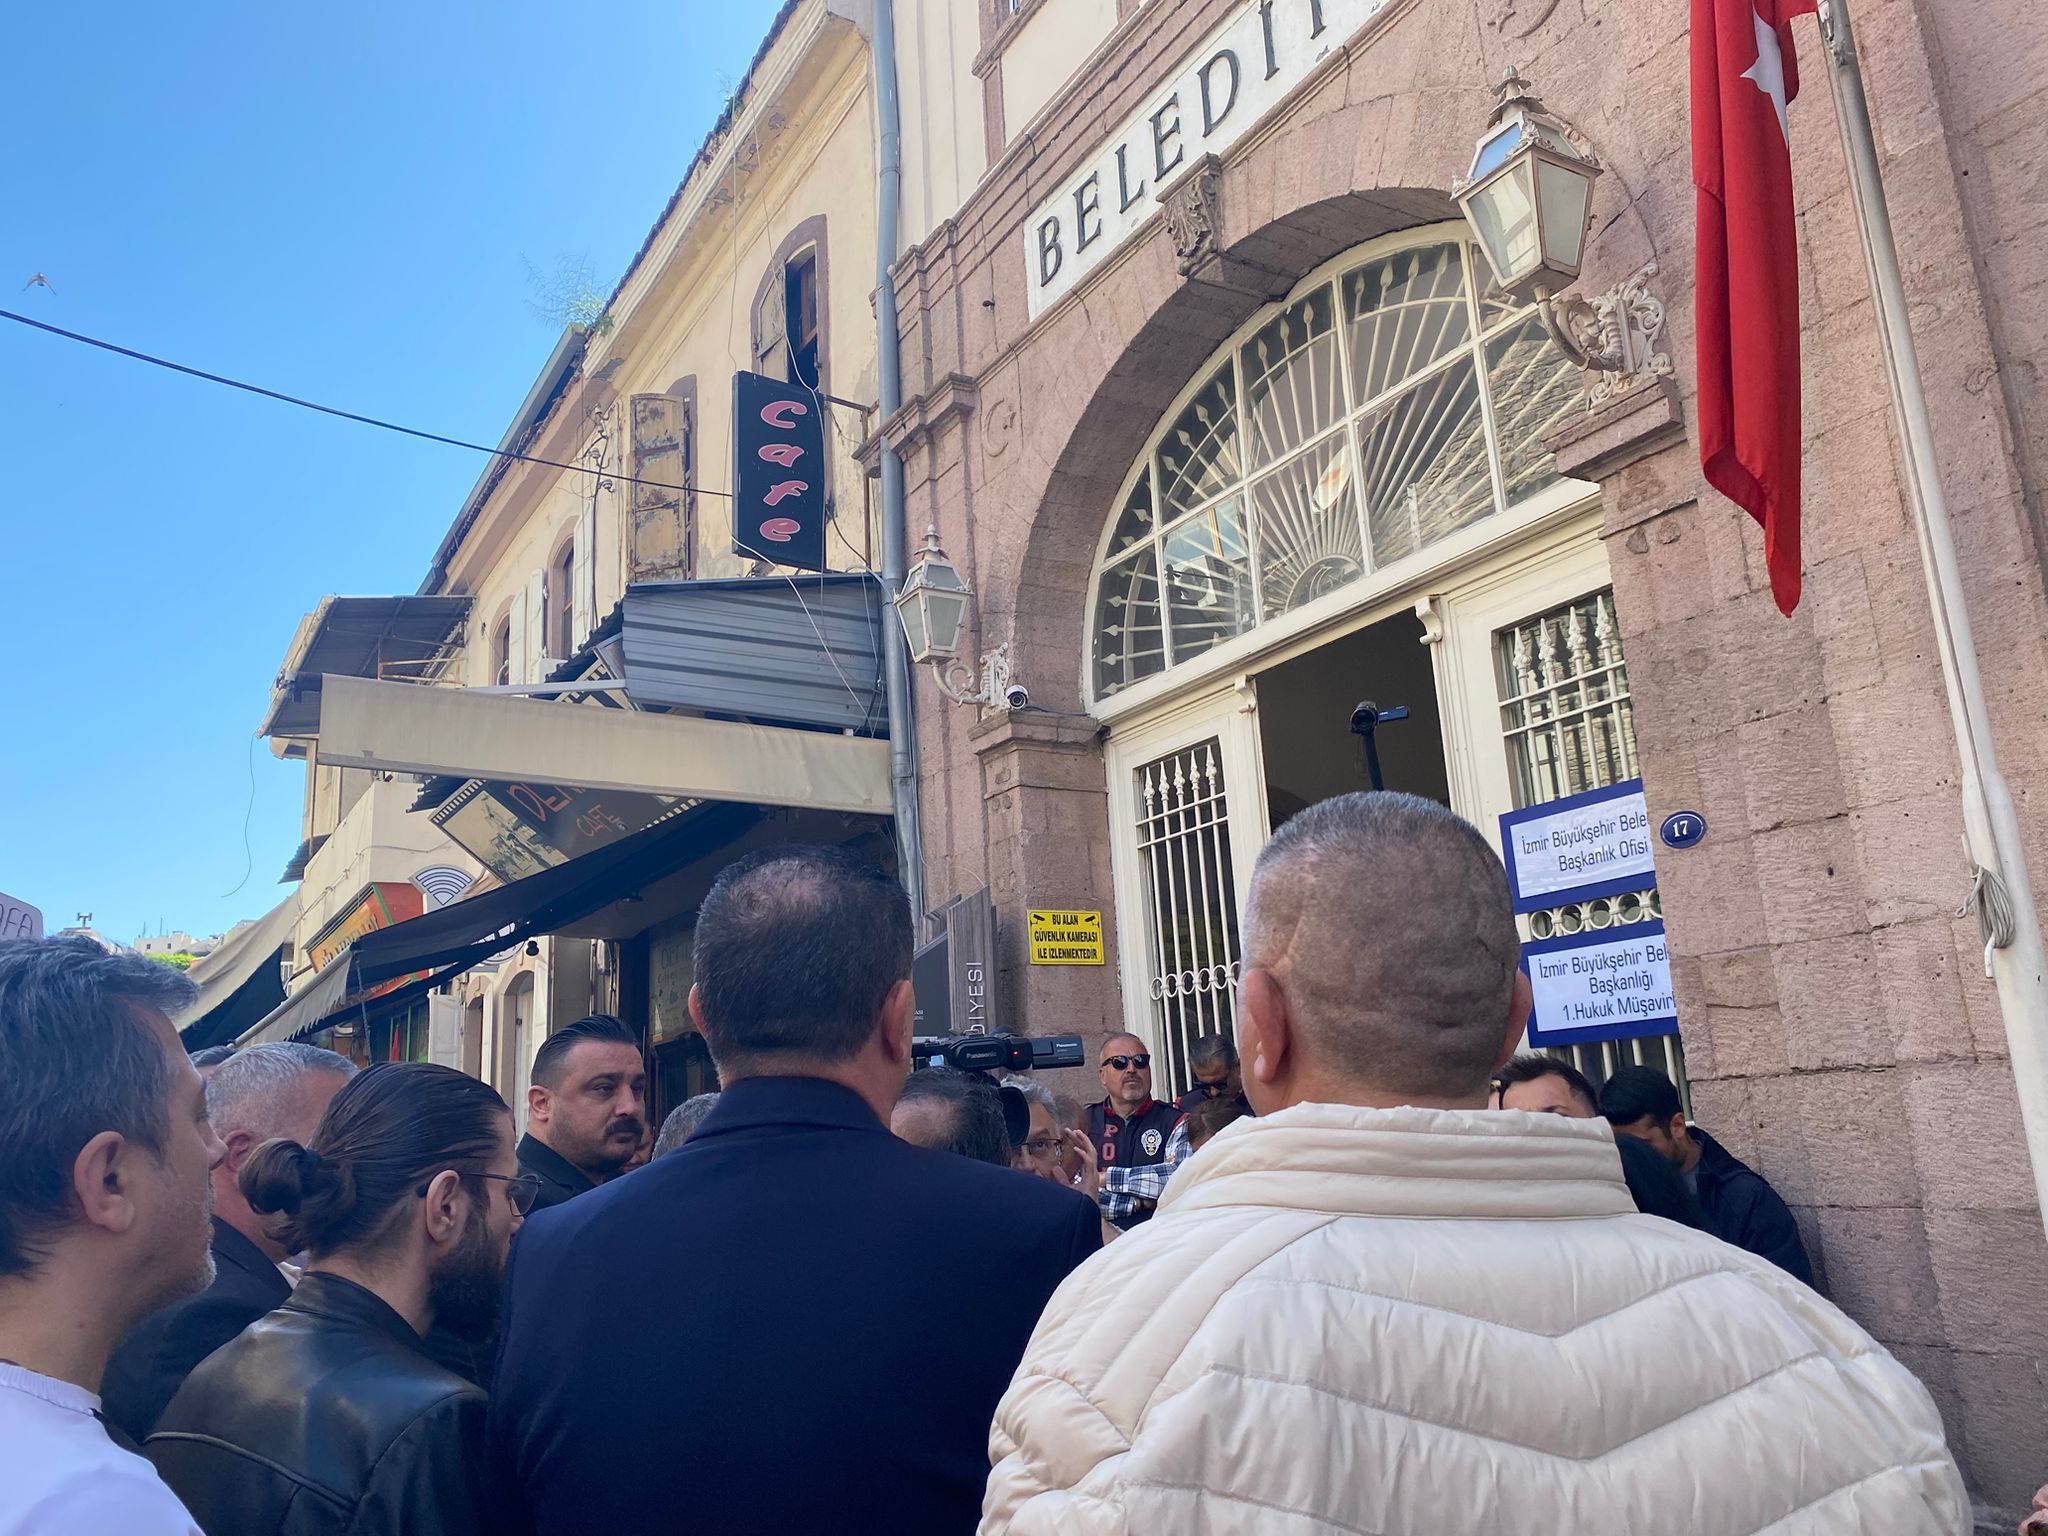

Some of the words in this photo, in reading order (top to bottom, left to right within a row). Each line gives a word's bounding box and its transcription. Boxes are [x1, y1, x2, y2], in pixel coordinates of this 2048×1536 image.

[1521, 834, 1550, 856] İzmir
[1552, 818, 1617, 849] Büyükşehir
[1672, 819, 1689, 838] 17
[1558, 845, 1617, 873] Başkanlık
[1619, 836, 1649, 857] Ofisi
[1052, 914, 1061, 925] BU
[1062, 914, 1079, 926] ALAN
[1538, 958, 1568, 979] İzmir
[1571, 948, 1642, 975] Büyükşehir
[1589, 969, 1654, 997] Başkanlığı
[1562, 999, 1615, 1022] 1.Hukuk
